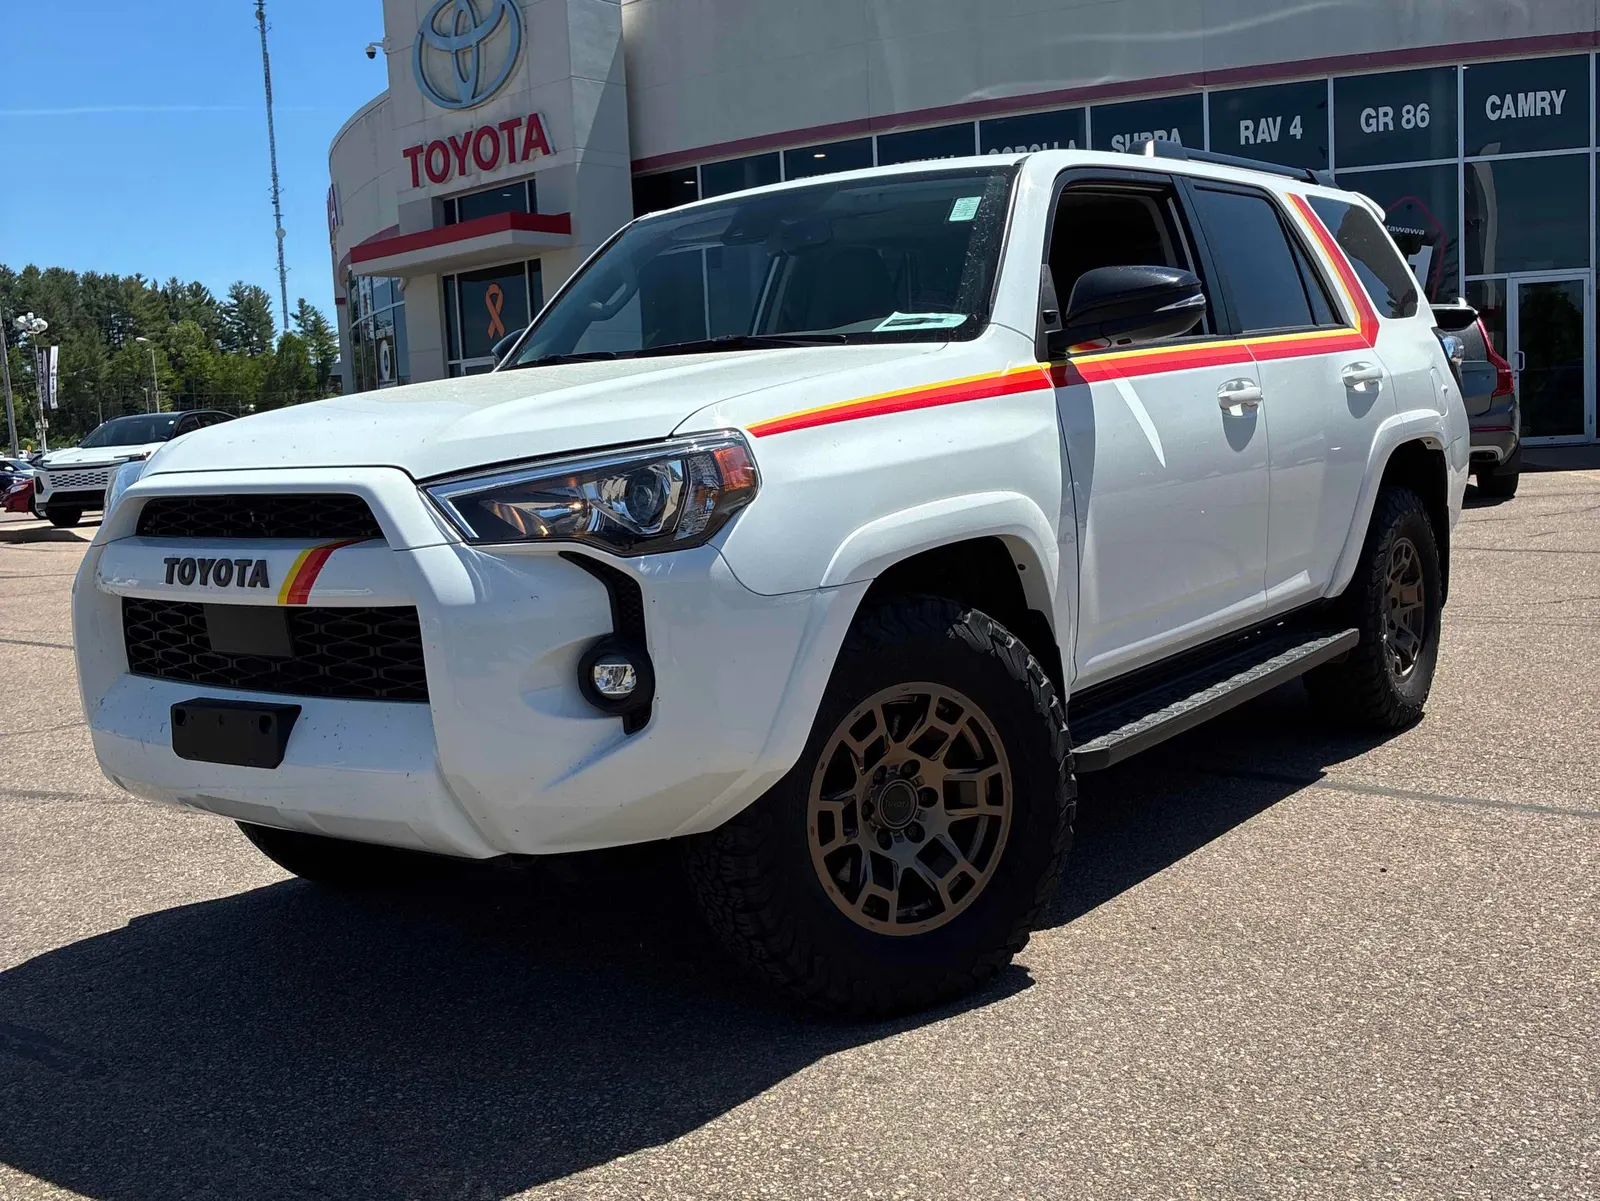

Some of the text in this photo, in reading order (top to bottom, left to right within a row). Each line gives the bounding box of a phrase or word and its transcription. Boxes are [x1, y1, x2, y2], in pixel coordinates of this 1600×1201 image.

[1360, 103, 1430, 134] GR 86
[1485, 89, 1567, 121] CAMRY
[1239, 115, 1303, 145] RAV 4
[402, 112, 551, 188] TOYOTA
[163, 557, 270, 589] TOYOTA
